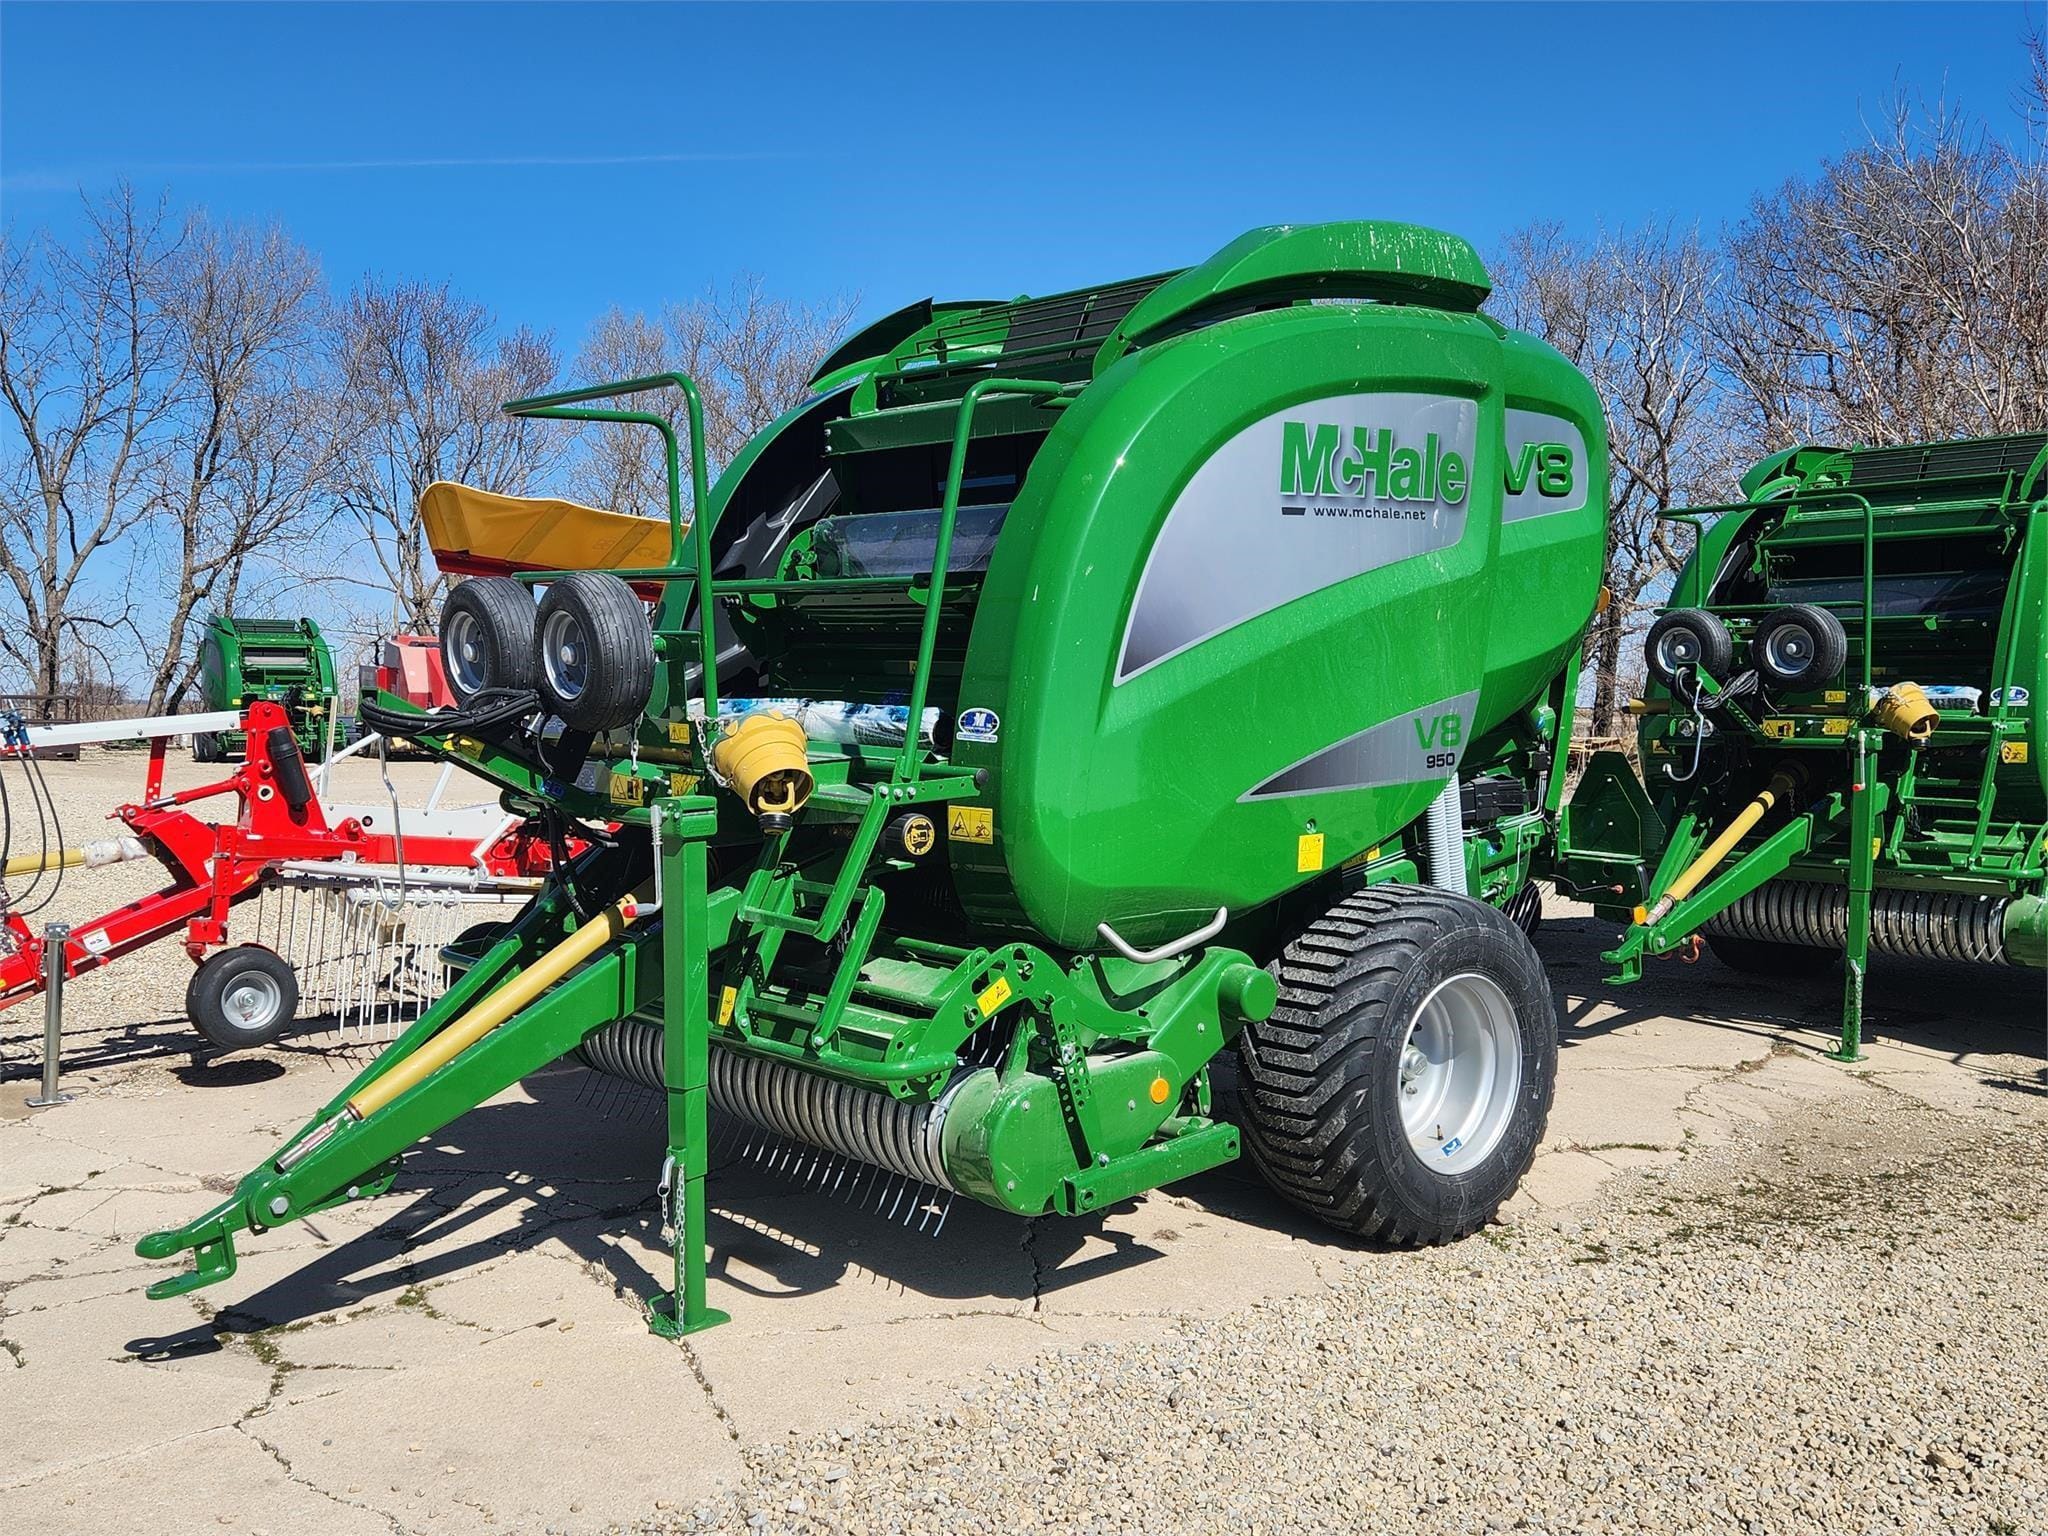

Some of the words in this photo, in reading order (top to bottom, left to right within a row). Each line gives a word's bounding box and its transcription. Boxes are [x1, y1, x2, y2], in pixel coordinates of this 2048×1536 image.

[1280, 421, 1467, 504] McHale
[1504, 442, 1573, 497] V8
[1313, 506, 1426, 521] www.mchale.net
[1413, 713, 1461, 750] V8
[1426, 752, 1456, 769] 950
